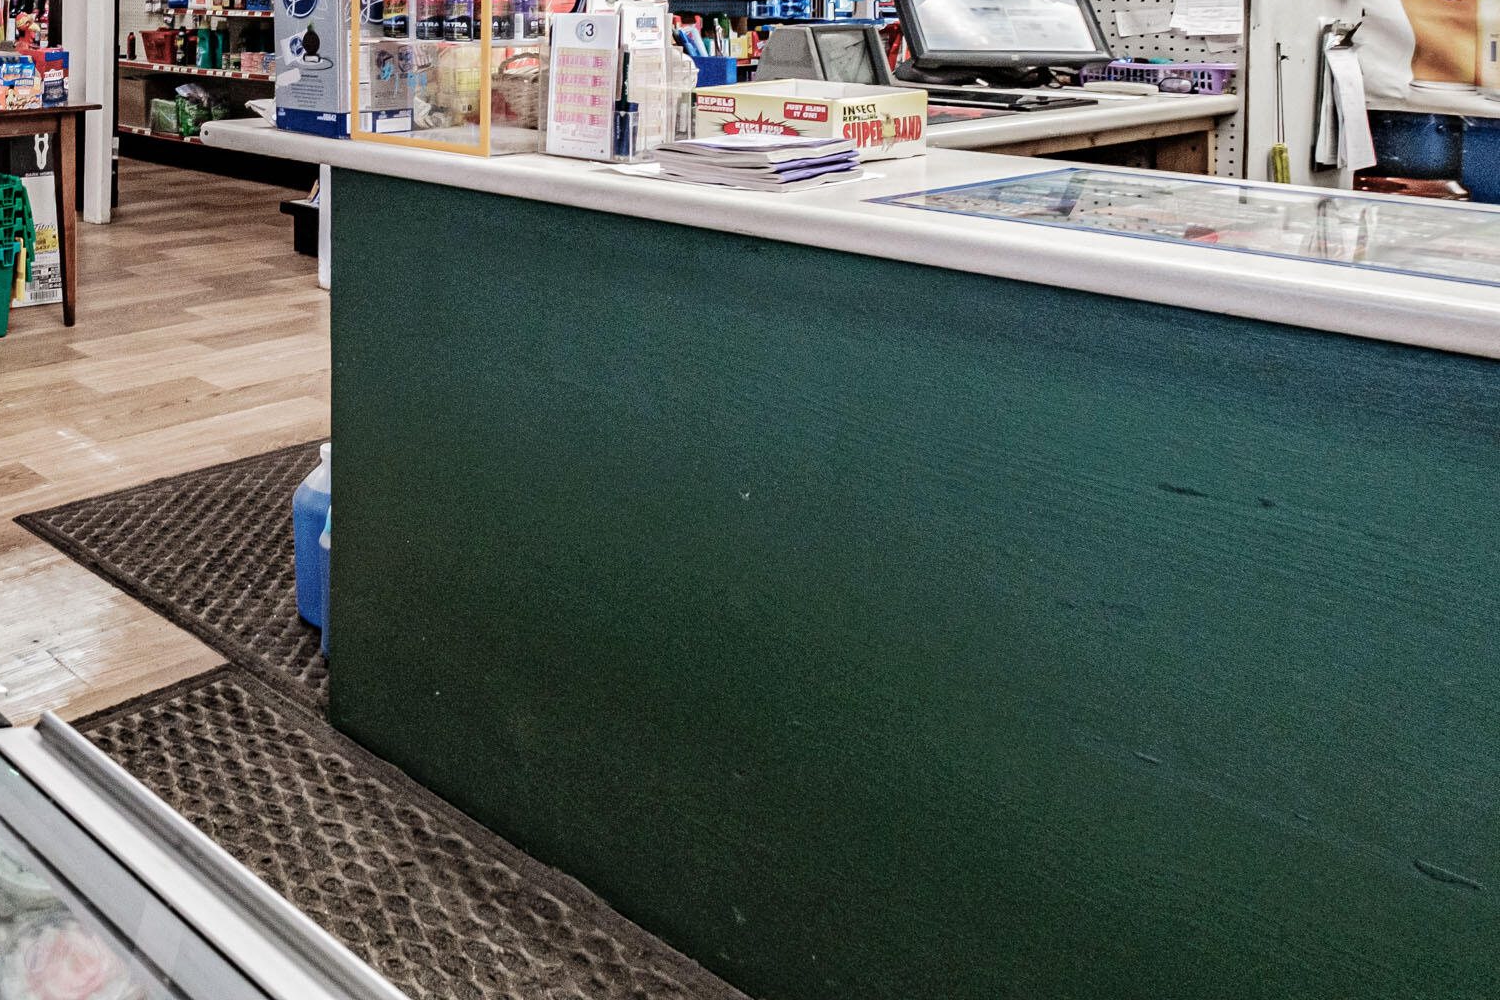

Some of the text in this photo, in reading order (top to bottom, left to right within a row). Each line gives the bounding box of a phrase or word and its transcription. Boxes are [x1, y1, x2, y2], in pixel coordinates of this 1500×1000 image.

[697, 96, 735, 107] REPELS
[785, 103, 826, 113] JUST SLIDE
[842, 103, 877, 115] INSECT
[842, 114, 922, 148] SUPER BAND
